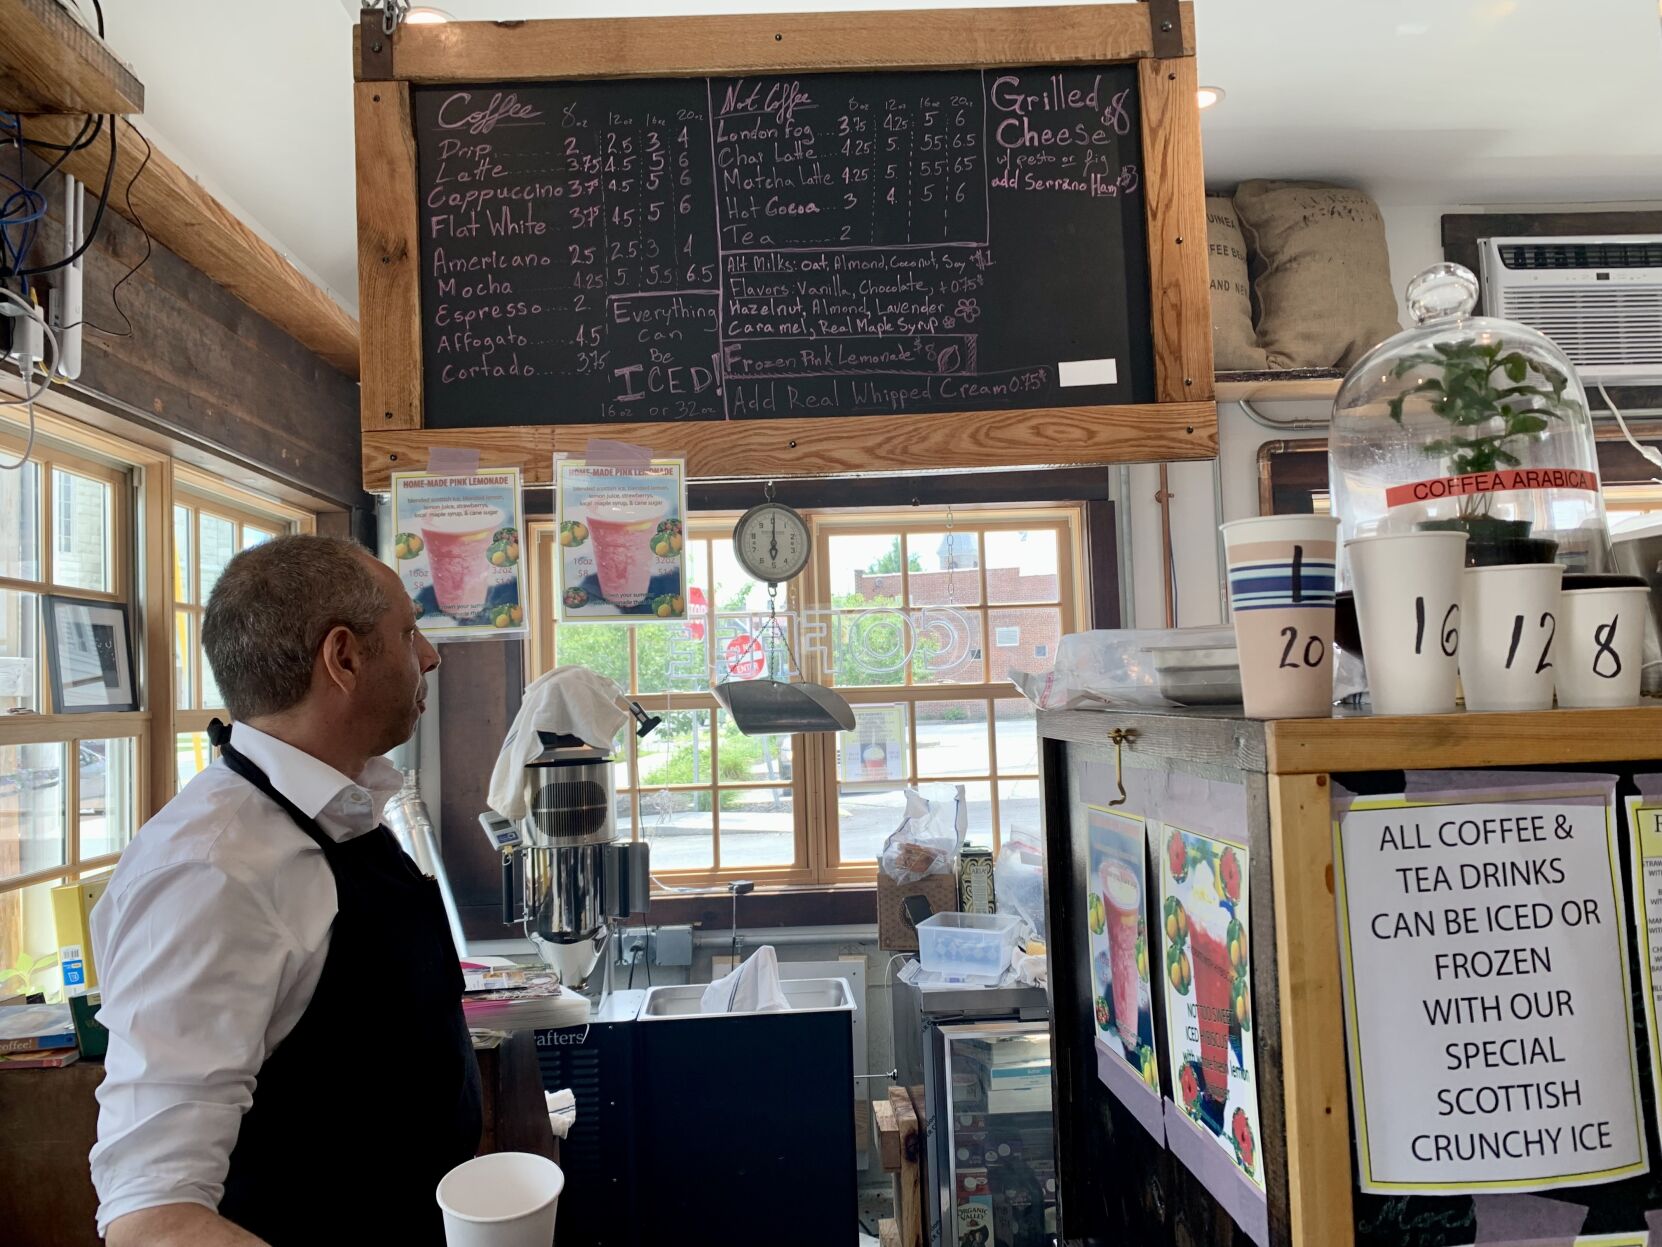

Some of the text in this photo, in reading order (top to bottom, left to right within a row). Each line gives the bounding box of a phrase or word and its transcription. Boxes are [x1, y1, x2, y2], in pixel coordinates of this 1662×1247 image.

[720, 79, 762, 115] Not
[765, 81, 812, 124] Coffee
[991, 73, 1102, 115] Grilled
[438, 92, 543, 134] Coffee
[717, 117, 778, 143] London
[923, 111, 940, 127] 5
[955, 109, 965, 126] 6
[438, 138, 492, 160] Drip
[645, 132, 661, 152] 3
[677, 125, 689, 149] 4
[995, 116, 1112, 149] Cheese
[436, 157, 509, 184] Latte
[604, 156, 637, 173] 4.5
[649, 151, 666, 170] 5
[678, 152, 690, 167] 6
[718, 144, 764, 168] Chai
[775, 140, 818, 162] Latte
[952, 133, 977, 148] 6.5
[1016, 150, 1056, 169] pesto
[1061, 154, 1077, 167] or
[1083, 149, 1109, 177] fig
[427, 183, 563, 213] Cappuccino
[608, 178, 635, 193] 4.5
[646, 171, 664, 190] 5
[679, 170, 692, 186] 6
[723, 165, 796, 192] Matcha
[798, 161, 834, 186] Latte
[954, 156, 977, 174] 6.5
[991, 168, 1117, 197] add Serrano Ham
[431, 208, 481, 238] Flat
[486, 201, 547, 237] White
[647, 202, 665, 221] 5
[679, 194, 692, 214] 6
[726, 195, 760, 219] Hot
[765, 196, 820, 216] Cocoa
[843, 193, 858, 210] 3
[921, 184, 936, 202] 5
[955, 182, 966, 203] 6
[722, 224, 852, 245] Tea 2
[1208, 244, 1230, 256] FEE
[433, 247, 551, 277] Americano
[646, 239, 660, 258] 3
[682, 233, 693, 257] 4
[727, 255, 748, 273] Alt
[942, 254, 966, 275] Soy
[438, 273, 513, 298] Mocha
[686, 264, 715, 283] 6.5
[797, 273, 856, 299] Vanilla,
[1209, 280, 1230, 292] AND
[435, 302, 542, 330] Espresso
[613, 297, 719, 332] Everything
[729, 296, 807, 318] Hazelnut,
[876, 295, 944, 316] Lavender
[437, 324, 528, 355] Affogato
[728, 316, 939, 340] Caramel, Real Maple Syrup
[441, 352, 535, 383] Cortado
[649, 348, 676, 363] Be
[724, 343, 796, 372] Frozen
[800, 344, 834, 368] Pink
[838, 344, 915, 366] Lemonade
[649, 406, 669, 416] or
[733, 377, 1007, 416] Add Real Whipped Cream
[403, 476, 509, 489] HOME-MADE PINK LEMONADE
[615, 467, 633, 476] PINK
[1413, 470, 1587, 501] COFFEA ARABICA
[1415, 596, 1460, 658] 16
[1504, 611, 1556, 675] 12
[1278, 626, 1325, 669] 20
[1592, 613, 1622, 679] 8
[1379, 813, 1574, 852] ALL COFFEE &
[1395, 857, 1566, 894] TEA DRINKS
[1370, 898, 1601, 940] CAN BE ICED OR
[1434, 946, 1552, 981] FROZEN
[1422, 989, 1575, 1026] WITH OUR
[1445, 1035, 1566, 1071] SPECIAL
[1437, 1079, 1582, 1116] SCOTTISH
[1411, 1121, 1613, 1162] CRUNCHY ICE
